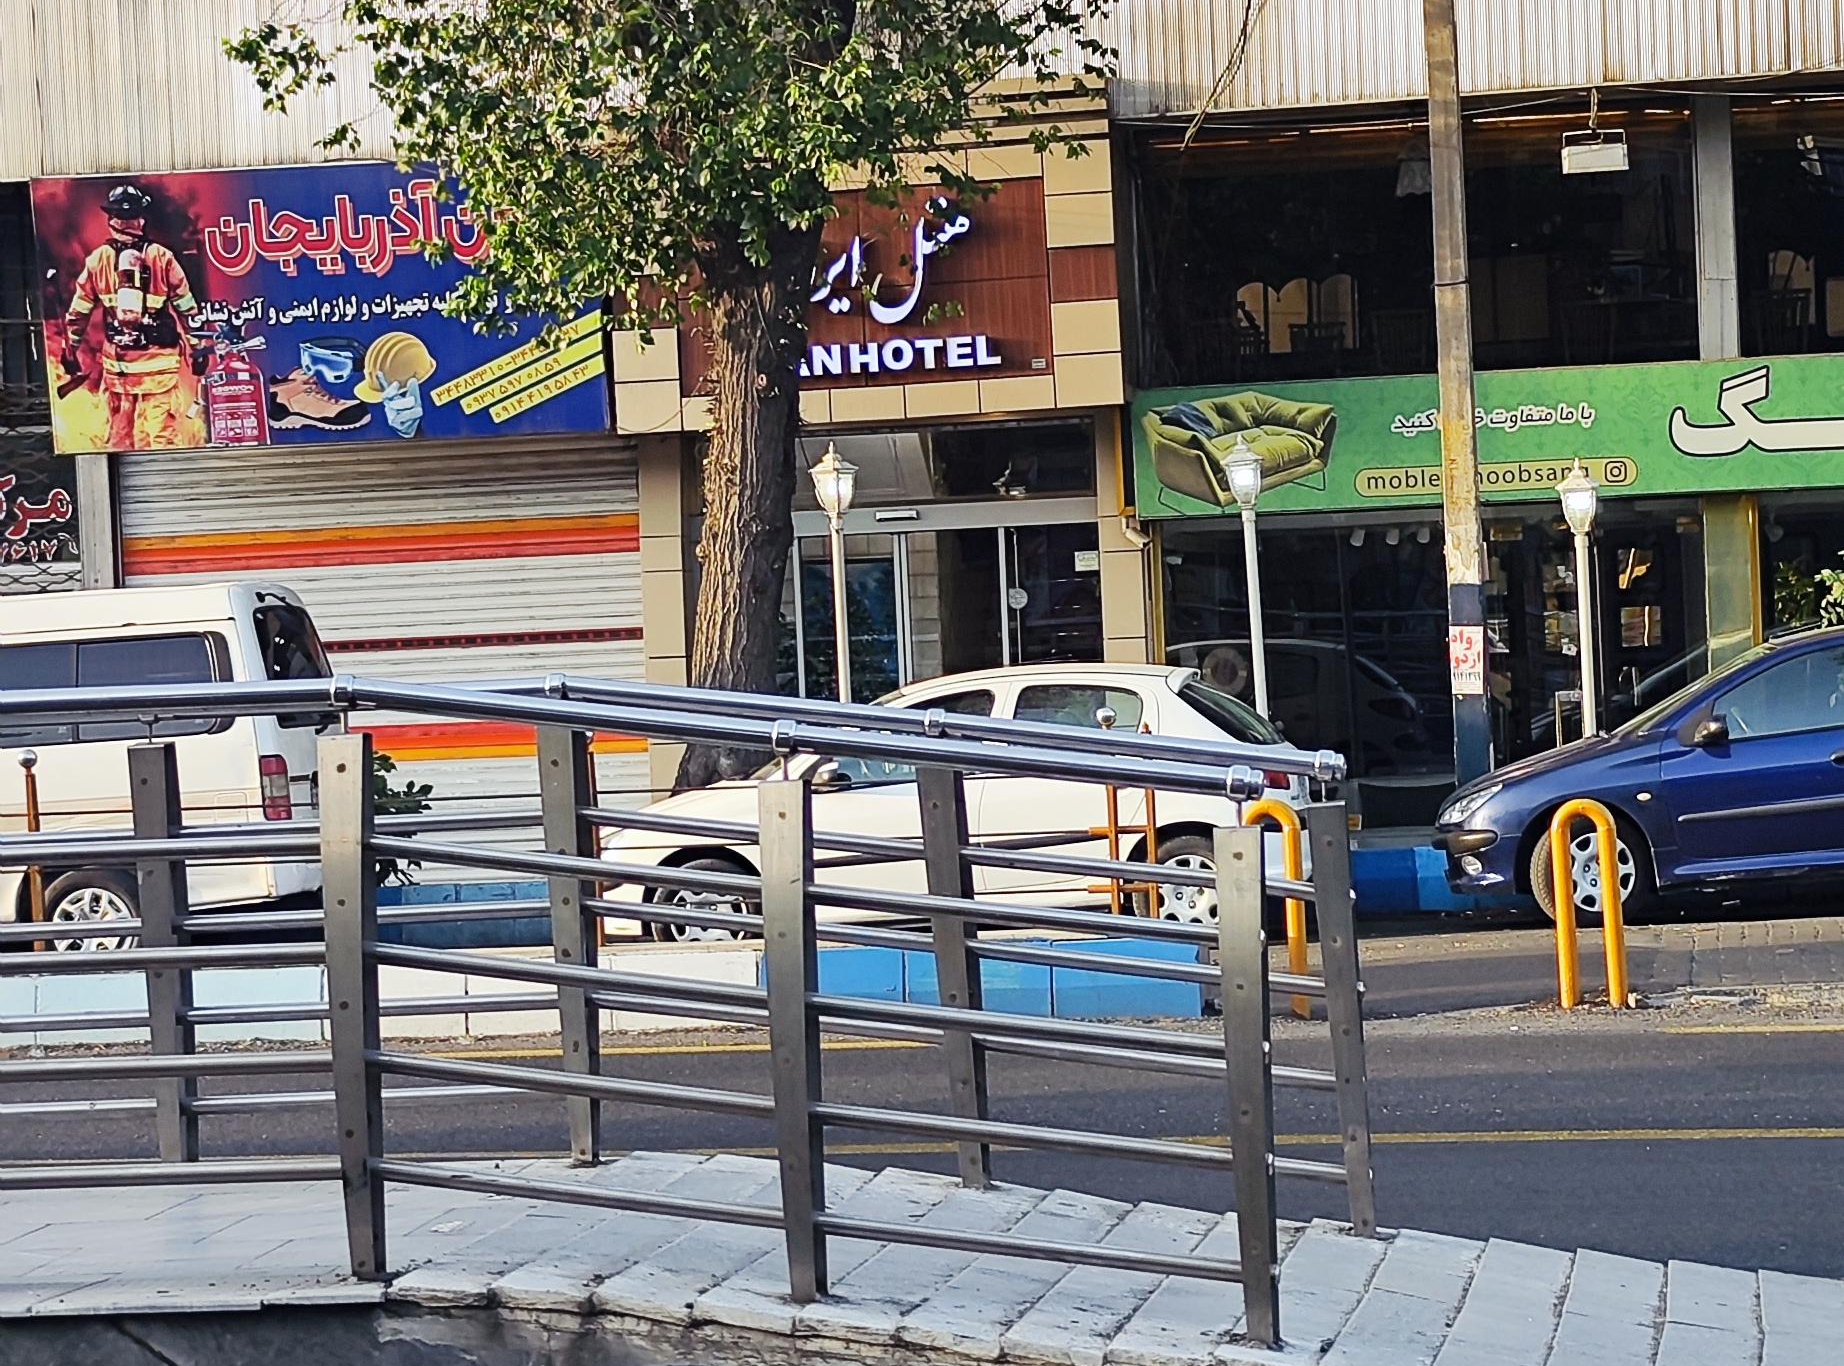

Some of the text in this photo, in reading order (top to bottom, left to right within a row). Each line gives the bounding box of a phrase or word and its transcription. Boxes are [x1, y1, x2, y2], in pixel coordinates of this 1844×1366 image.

[204, 178, 438, 276] آذربایجان
[808, 235, 862, 315] ایر
[187, 300, 229, 328] نشانی
[231, 296, 265, 326] آتش
[267, 306, 276, 325] و
[278, 296, 319, 324] ایمنی
[321, 293, 357, 323] لوازم
[361, 304, 370, 321] و
[371, 291, 430, 319] تجهیزات
[1391, 410, 1436, 435] کنید
[1488, 406, 1555, 430] متفاوت
[1558, 404, 1575, 423] ما
[1579, 403, 1595, 426] با
